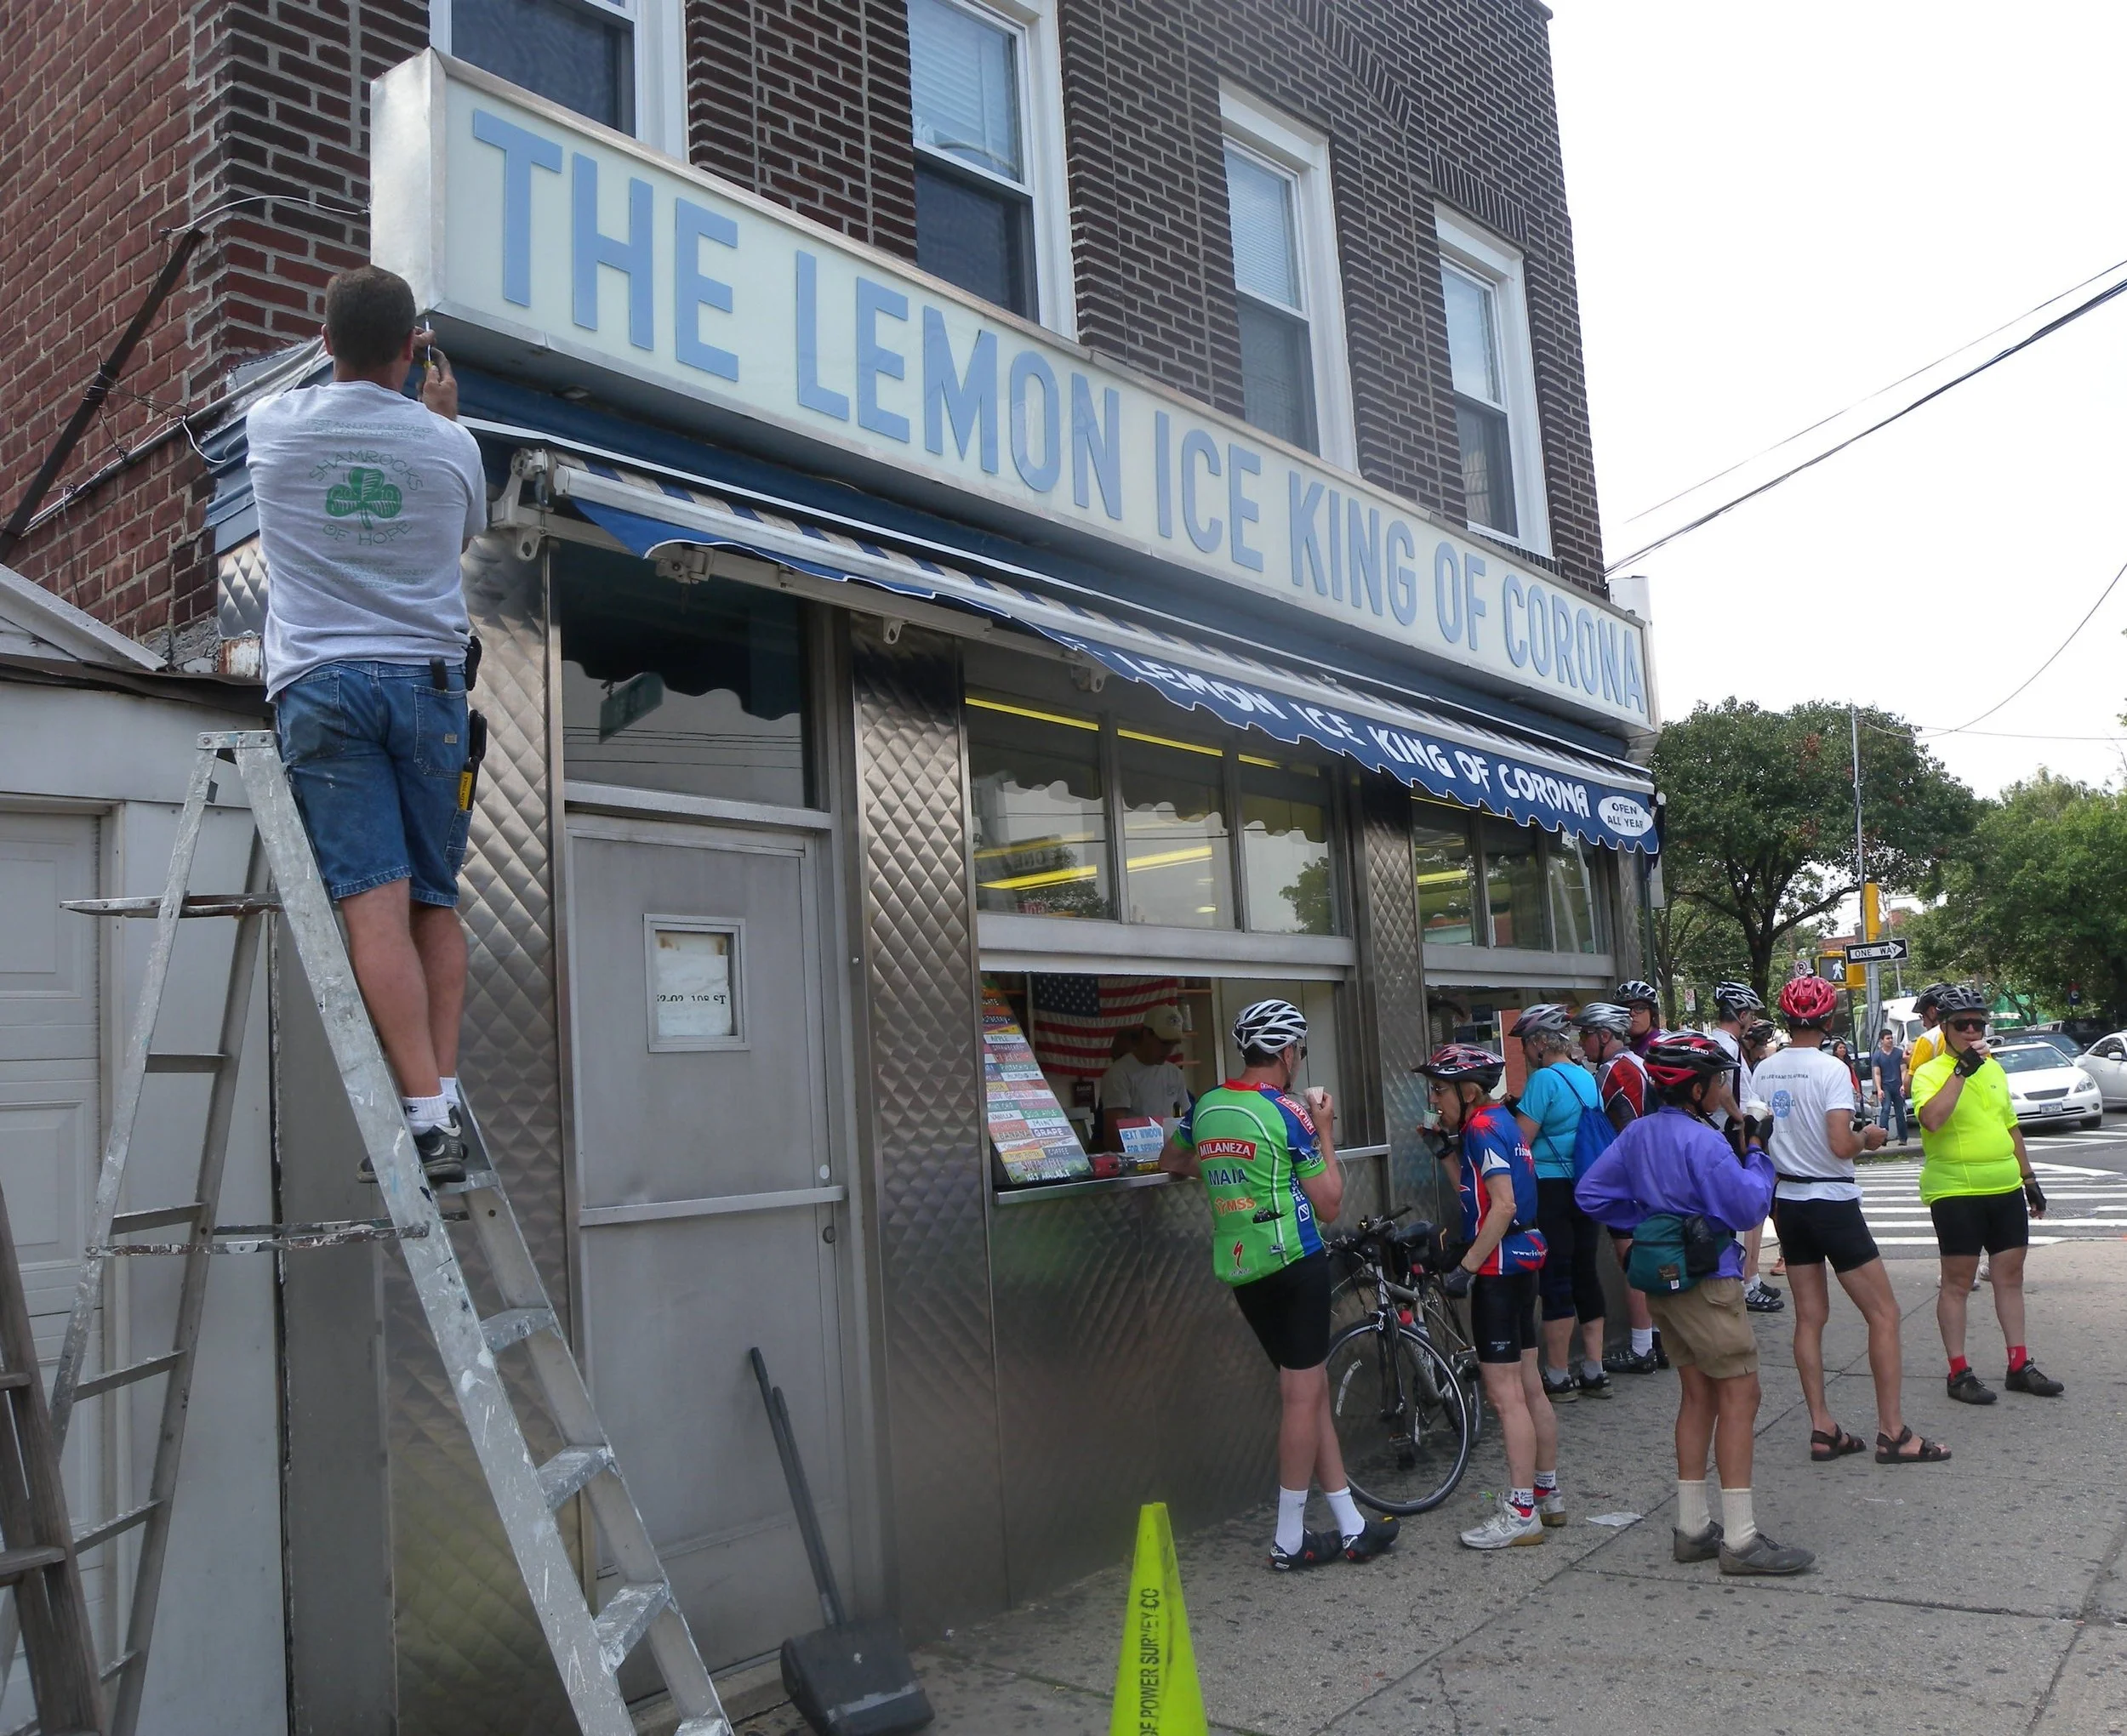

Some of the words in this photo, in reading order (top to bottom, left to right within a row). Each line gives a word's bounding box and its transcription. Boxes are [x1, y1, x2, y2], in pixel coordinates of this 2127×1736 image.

[473, 108, 738, 382] THE
[797, 250, 1122, 520] LEMON
[1155, 411, 1263, 572] ICE
[1290, 470, 1417, 626] KING
[1434, 541, 1486, 651] OF
[1503, 575, 1645, 714] CORONA
[309, 450, 424, 491] SHAMROCKS
[322, 522, 350, 543] OF
[358, 521, 413, 545] HOPE
[1111, 652, 1288, 720] LEMON
[1289, 702, 1367, 746] ICE
[1367, 726, 1455, 778] KING
[1453, 751, 1491, 792] OF
[1498, 765, 1591, 819] CORONA
[1611, 802, 1638, 816] OPEN
[1607, 815, 1622, 826] ALL
[1624, 817, 1644, 829] YEAR
[1855, 949, 1872, 958] ONE
[1879, 946, 1897, 955] WAY
[1689, 1046, 1709, 1056] GIRO
[1281, 1096, 1314, 1130] MILANEZA
[1032, 1118, 1055, 1127] MINT
[998, 1130, 1030, 1140] BANANA
[1034, 1128, 1064, 1137] GRAPE
[1121, 1130, 1138, 1141] NEXT
[1138, 1127, 1162, 1139] WINDOW
[1126, 1145, 1139, 1153] FOR
[1200, 1141, 1252, 1158] MILANEZA
[1207, 1168, 1250, 1186] MAIA
[1226, 1197, 1255, 1212] MSS
[1139, 1612, 1159, 1665] SURVEY
[1139, 1669, 1159, 1718] POWER
